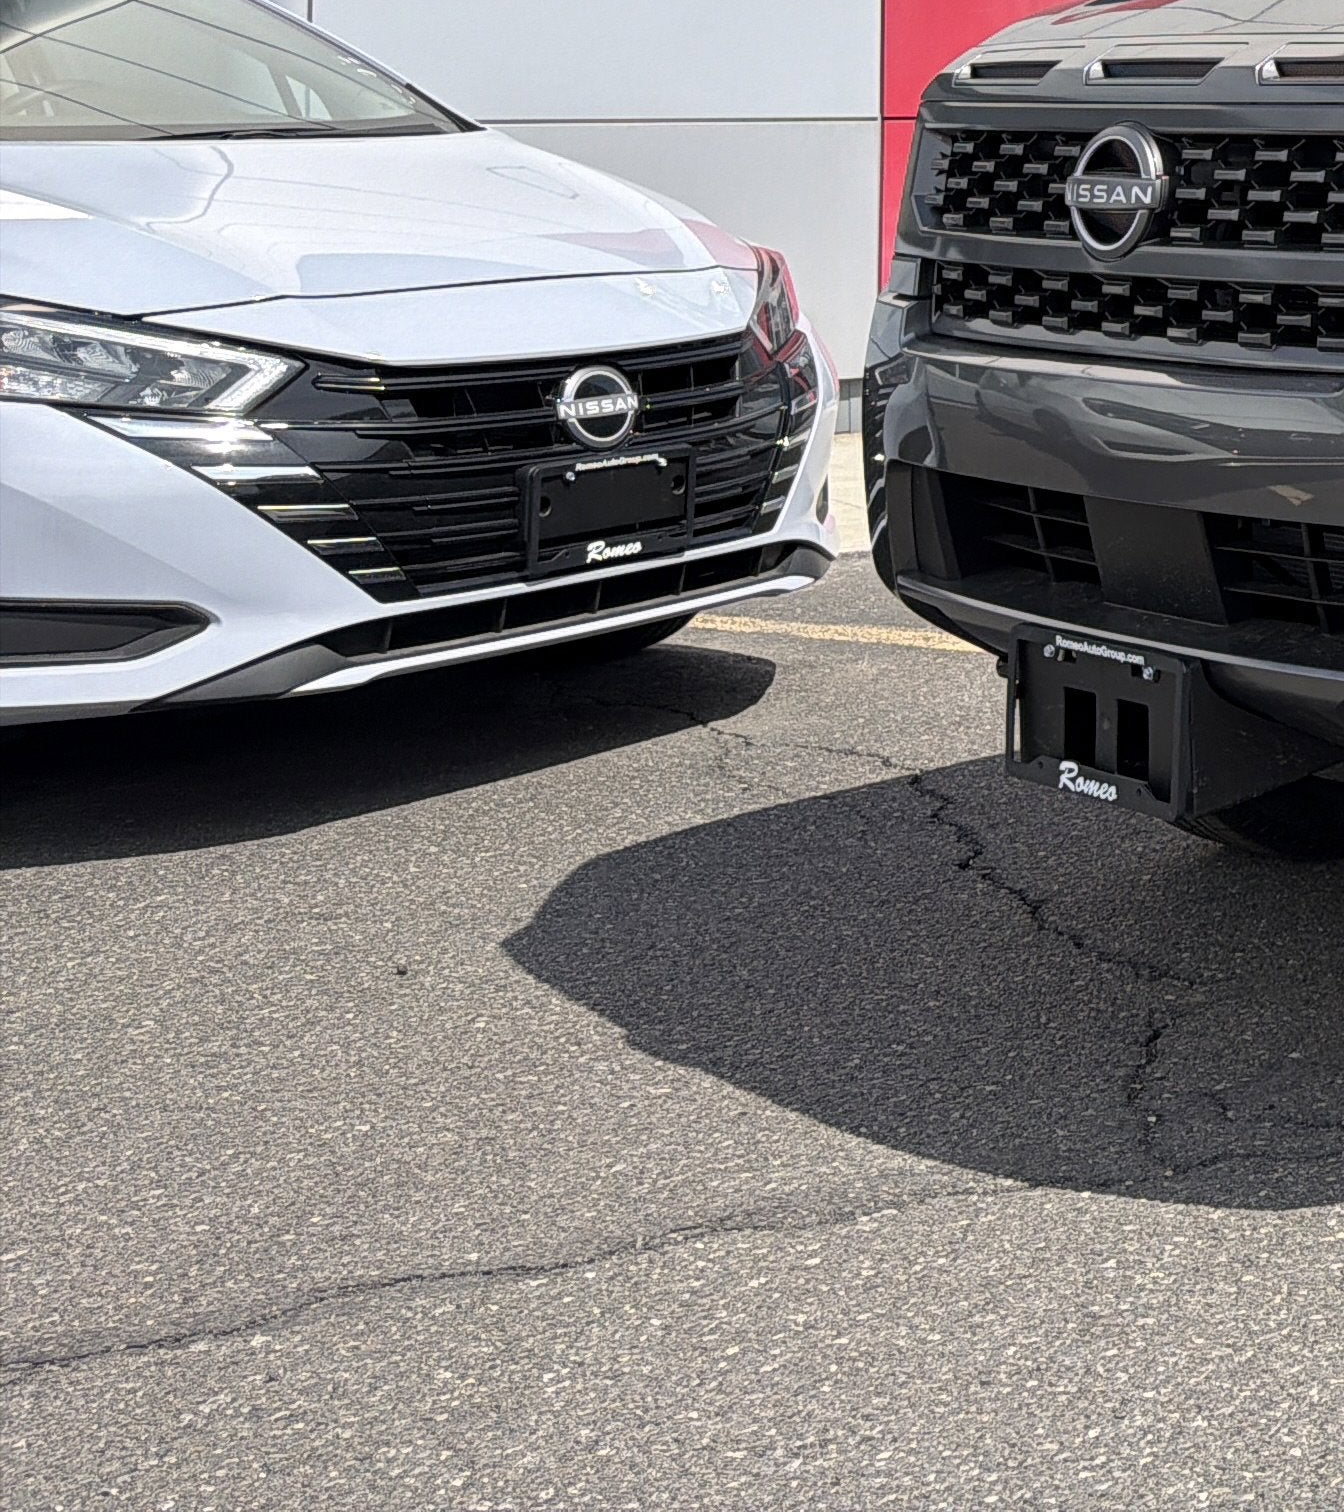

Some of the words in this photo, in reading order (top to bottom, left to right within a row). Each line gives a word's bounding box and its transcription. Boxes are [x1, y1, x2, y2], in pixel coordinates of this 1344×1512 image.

[1065, 182, 1153, 205] NISSAN
[559, 394, 639, 419] NISSAN
[585, 539, 643, 564] Romeo
[1055, 634, 1145, 666] RomeoAutoGroup.com
[1058, 760, 1118, 802] Romeo
